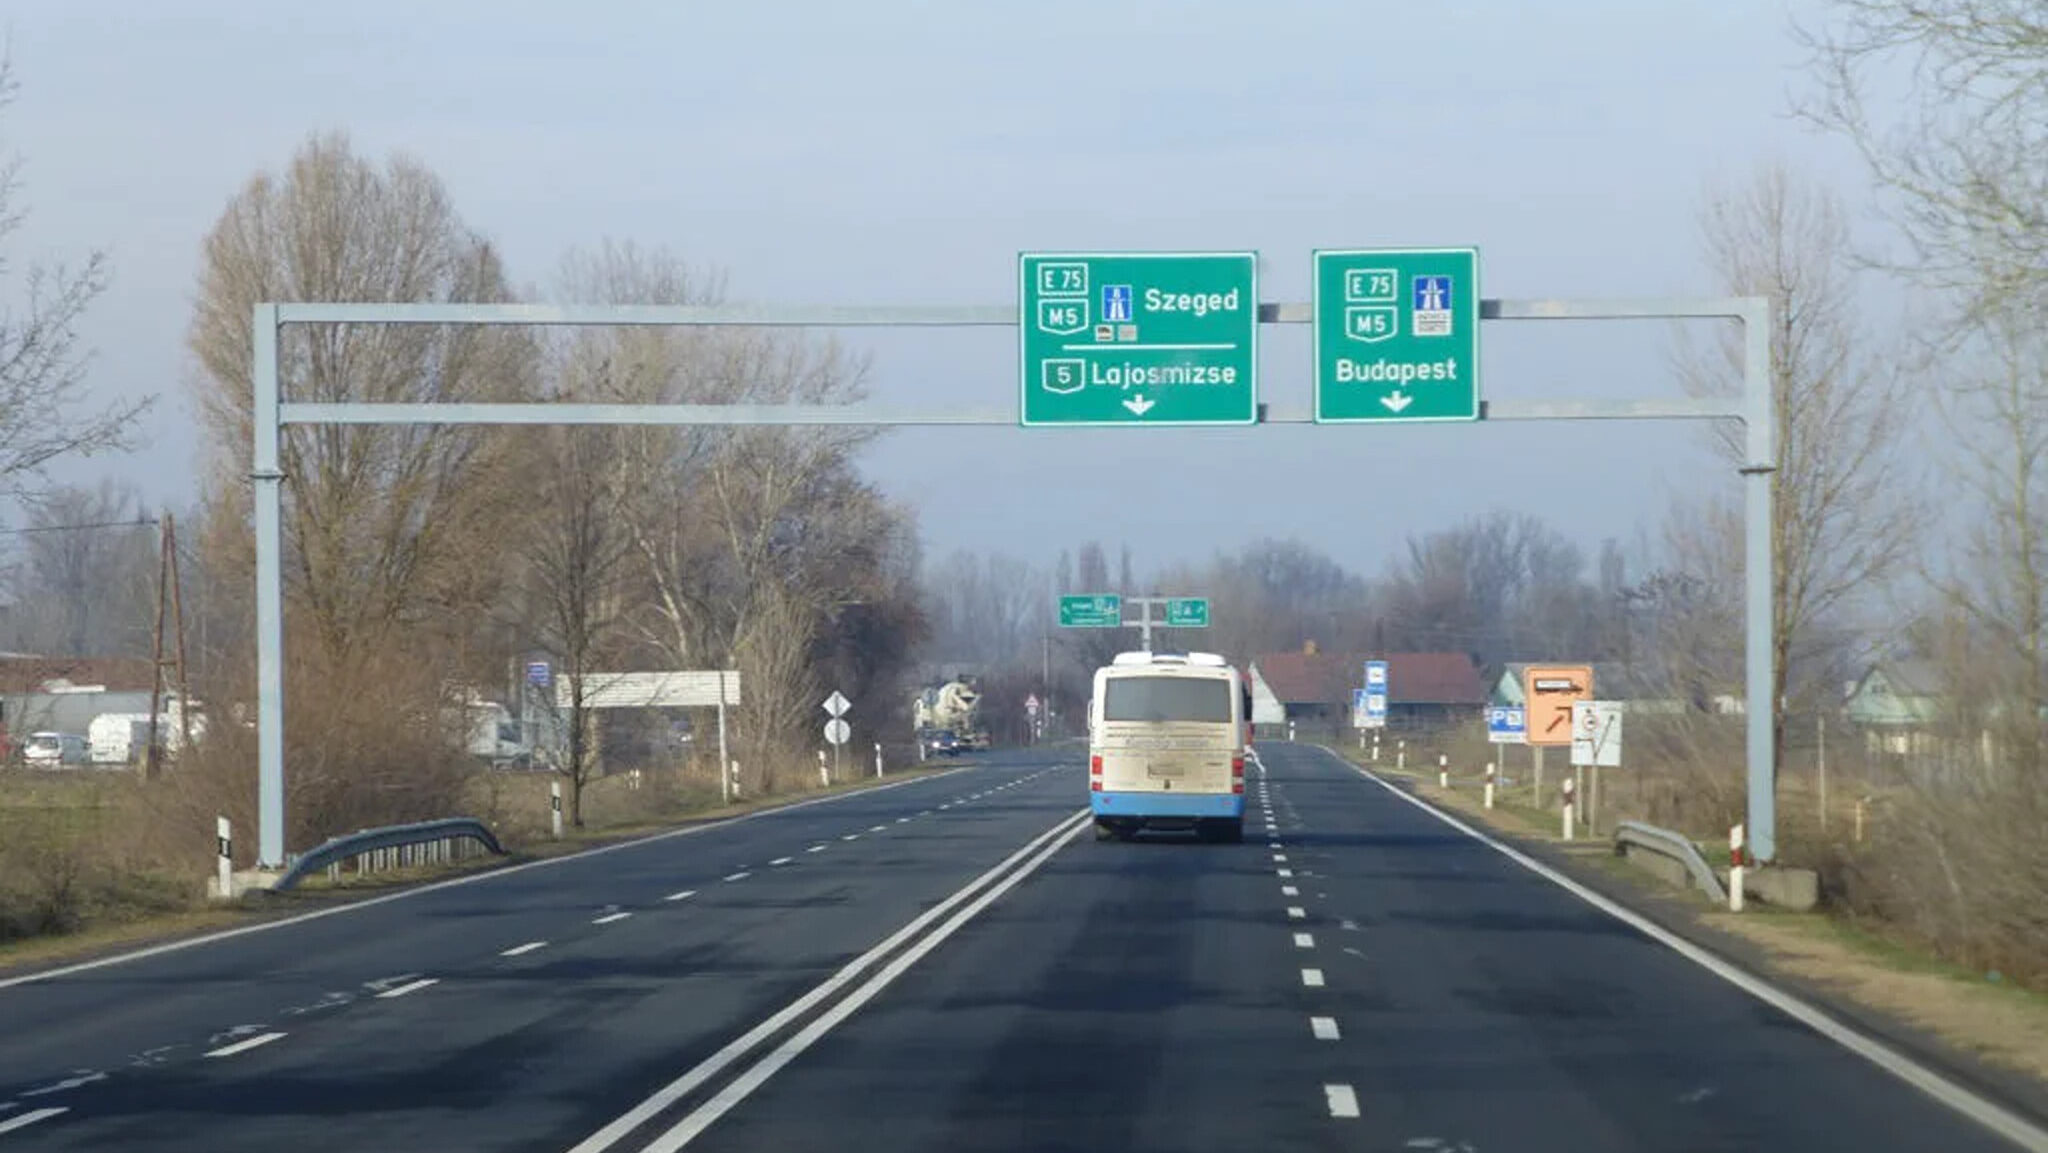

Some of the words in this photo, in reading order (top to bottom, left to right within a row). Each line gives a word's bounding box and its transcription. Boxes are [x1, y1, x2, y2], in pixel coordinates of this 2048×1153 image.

[1044, 270, 1054, 289] E
[1061, 270, 1082, 289] 75
[1352, 276, 1363, 295] E
[1370, 276, 1390, 294] 75
[1144, 288, 1239, 316] Szeged
[1056, 366, 1072, 384] 5
[1091, 361, 1237, 390] Lajosmizse
[1335, 357, 1457, 387] Budapest
[1492, 709, 1503, 724] P
